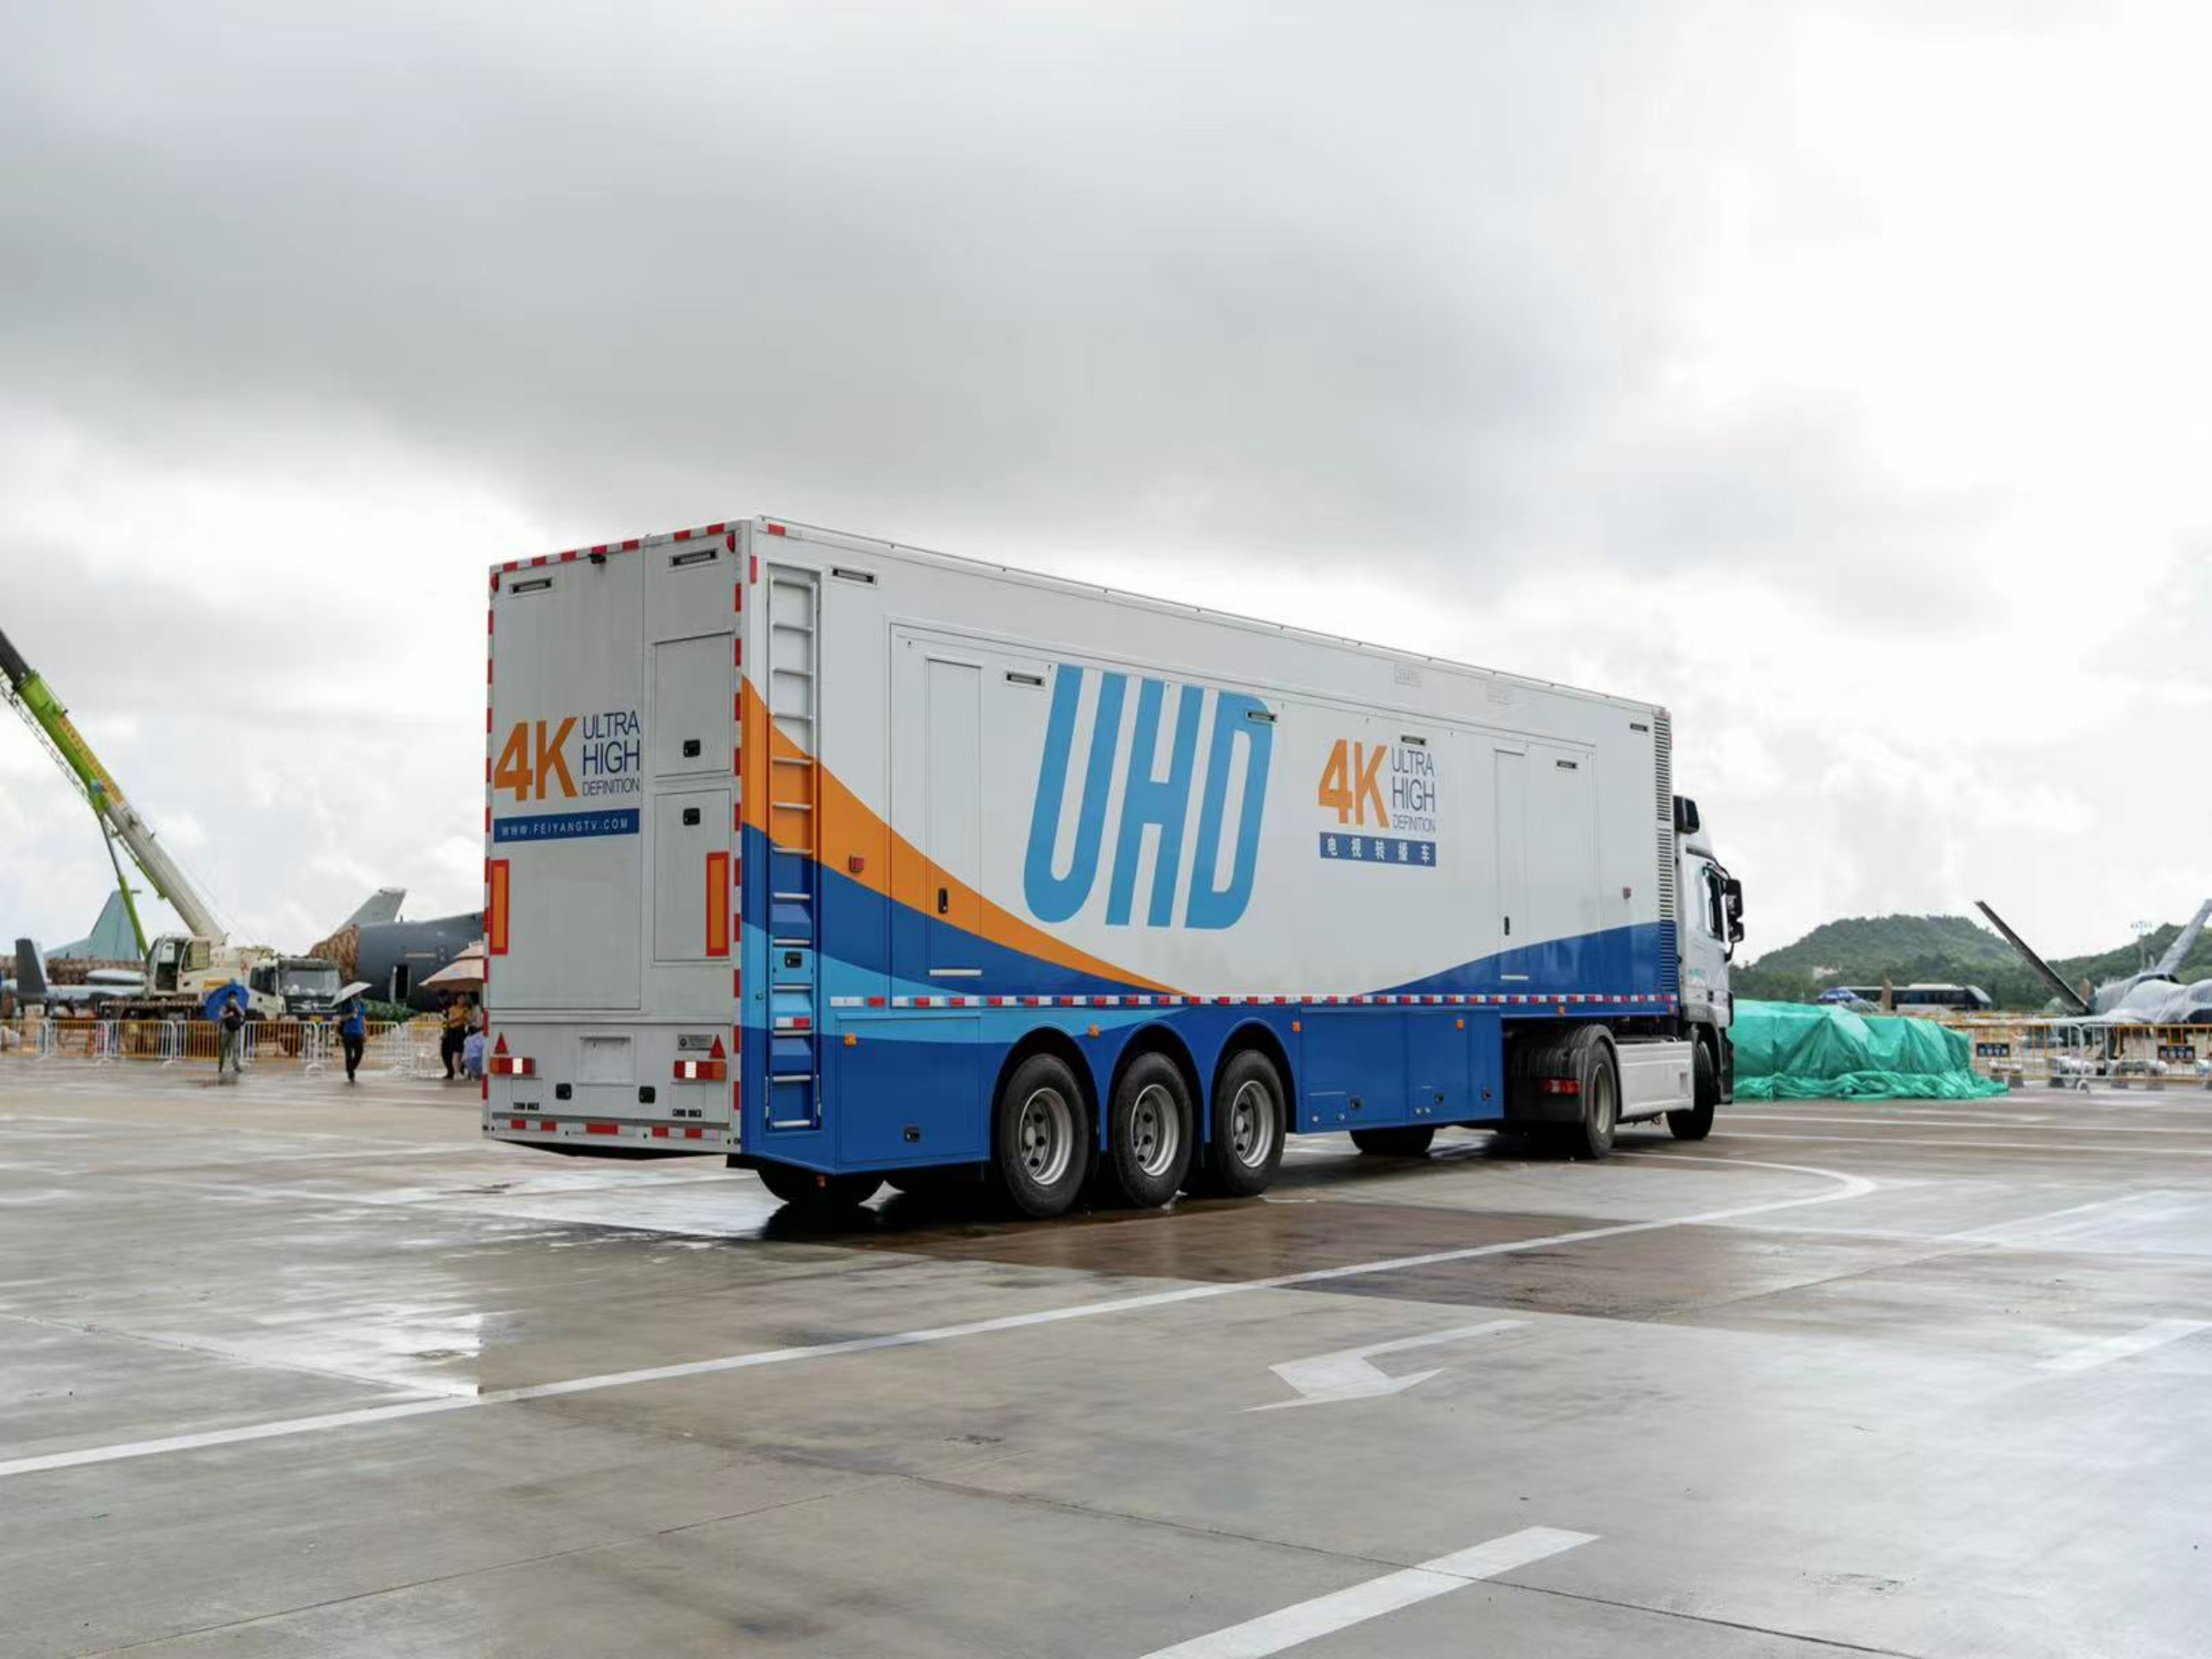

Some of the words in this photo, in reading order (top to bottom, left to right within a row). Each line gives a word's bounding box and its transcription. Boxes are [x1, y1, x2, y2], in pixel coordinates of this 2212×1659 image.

[582, 710, 640, 739] ULTRA
[494, 716, 578, 801] 4K
[582, 741, 640, 776] HIGH
[1392, 747, 1434, 776] ULTRA
[582, 779, 640, 797] DEFINITION
[1024, 664, 1273, 930] UHD
[1319, 739, 1389, 829] 4K
[1392, 777, 1435, 812] HIGH
[501, 818, 628, 836] WWW.FEIYANGTV.COM
[1393, 815, 1436, 833] DEFINITION
[1327, 836, 1430, 863] 电视转播车
